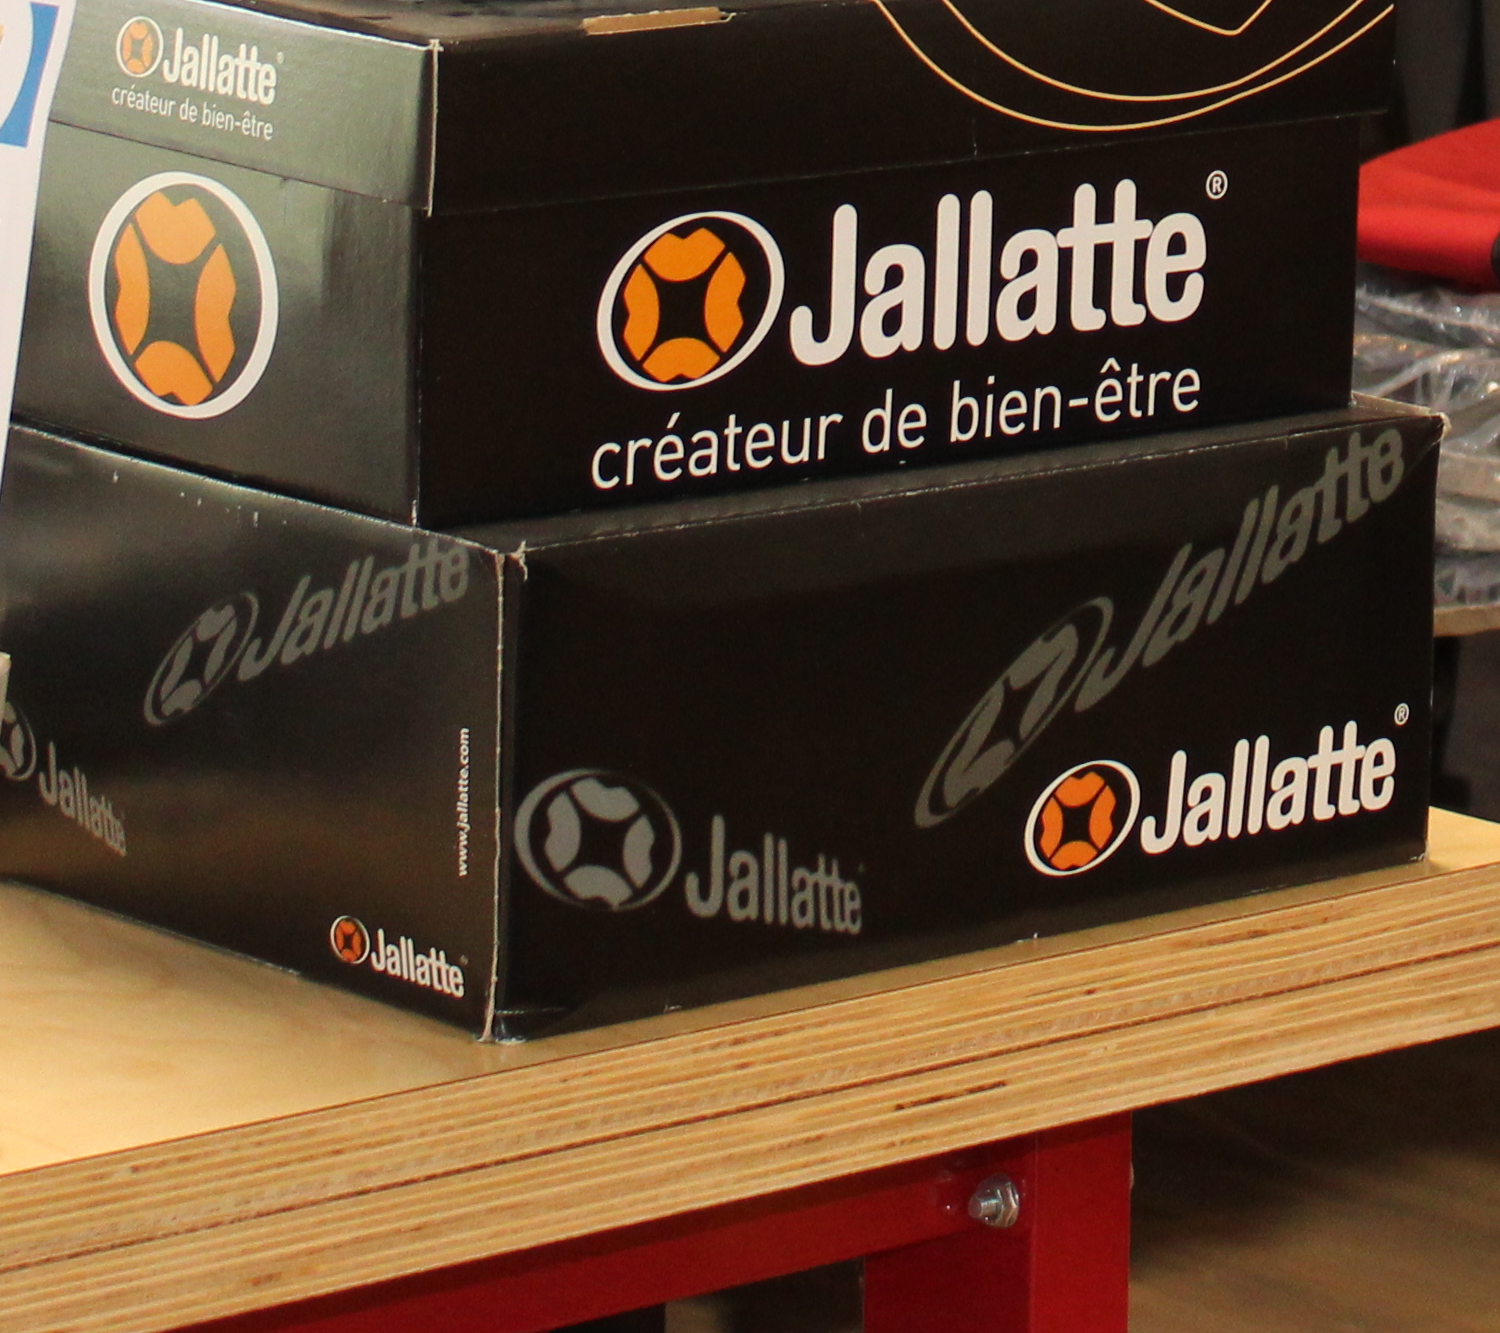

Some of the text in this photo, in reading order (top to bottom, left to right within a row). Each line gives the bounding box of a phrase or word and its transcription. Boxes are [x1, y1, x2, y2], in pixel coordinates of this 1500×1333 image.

[111, 84, 274, 141] créateur de bien-être
[162, 25, 278, 107] Jallatte
[789, 178, 1208, 366] Jallatte
[591, 358, 1202, 490] créateur de bien-être
[237, 537, 471, 682] Jallatte
[1074, 428, 1406, 713] Jallatte
[38, 742, 127, 857] Jallatte
[454, 727, 471, 878] www.jallatte.com
[1139, 720, 1396, 855] Jallatte
[685, 814, 862, 935] Jallatte
[370, 928, 465, 1000] Jallatte
